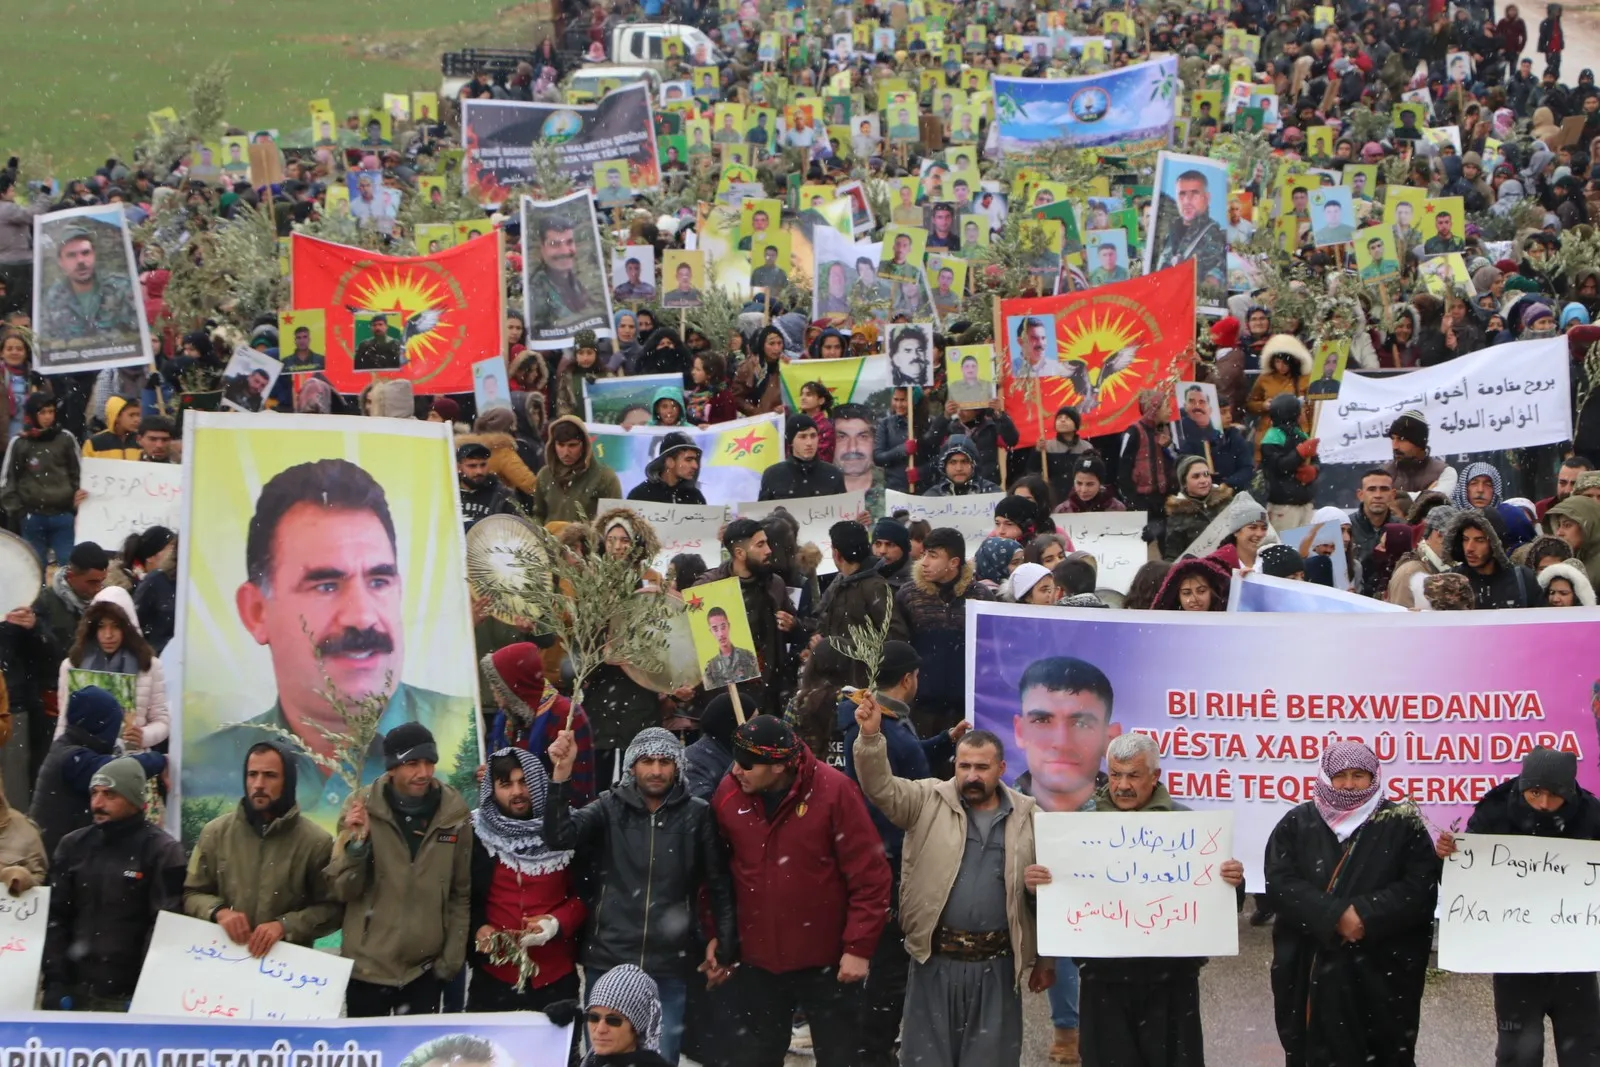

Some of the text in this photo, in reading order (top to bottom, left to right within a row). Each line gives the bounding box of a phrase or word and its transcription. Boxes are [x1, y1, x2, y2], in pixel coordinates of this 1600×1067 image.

[1477, 377, 1522, 396] مقاومة
[1524, 378, 1556, 396] بروح
[1167, 688, 1544, 721] BI RIHÊ BERXWEDANIYA
[1373, 730, 1397, 761] Û
[1404, 730, 1481, 761] ÎLAN
[1502, 907, 1533, 925] me
